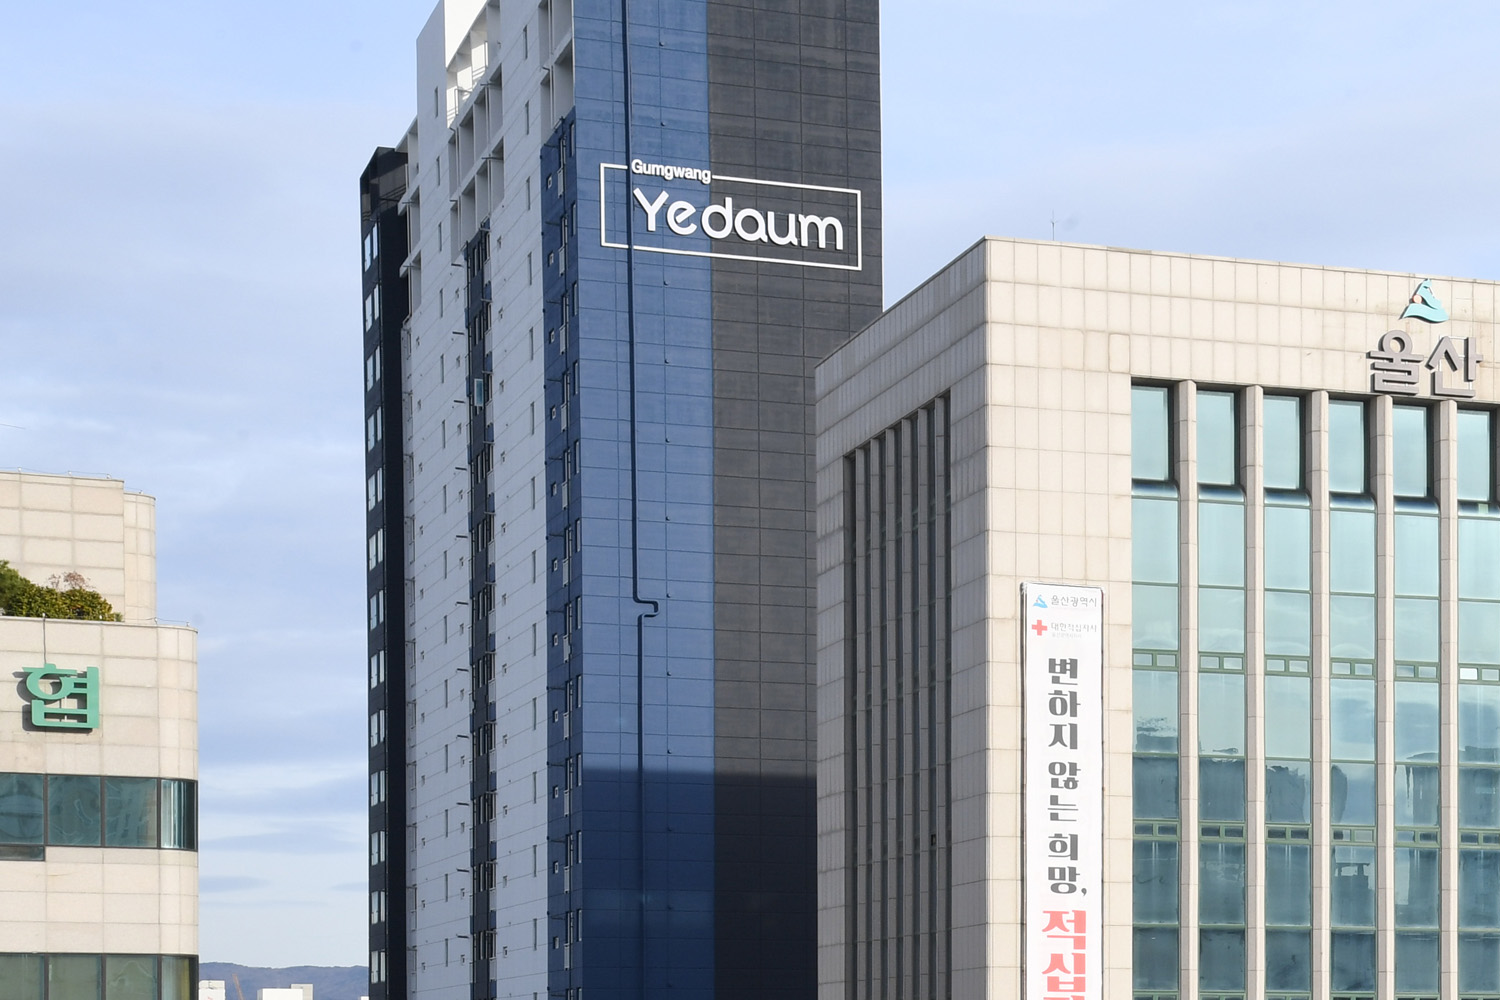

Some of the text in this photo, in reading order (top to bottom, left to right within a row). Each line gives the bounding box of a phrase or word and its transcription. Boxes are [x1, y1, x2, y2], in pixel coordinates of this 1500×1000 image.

[631, 158, 711, 184] Gumgwang
[632, 187, 844, 251] Yedaum
[1366, 329, 1484, 398] 울산
[1051, 594, 1097, 608] 울산광역시
[21, 663, 99, 729] 협
[1047, 657, 1082, 750] 변하지
[1047, 761, 1081, 822] 않는
